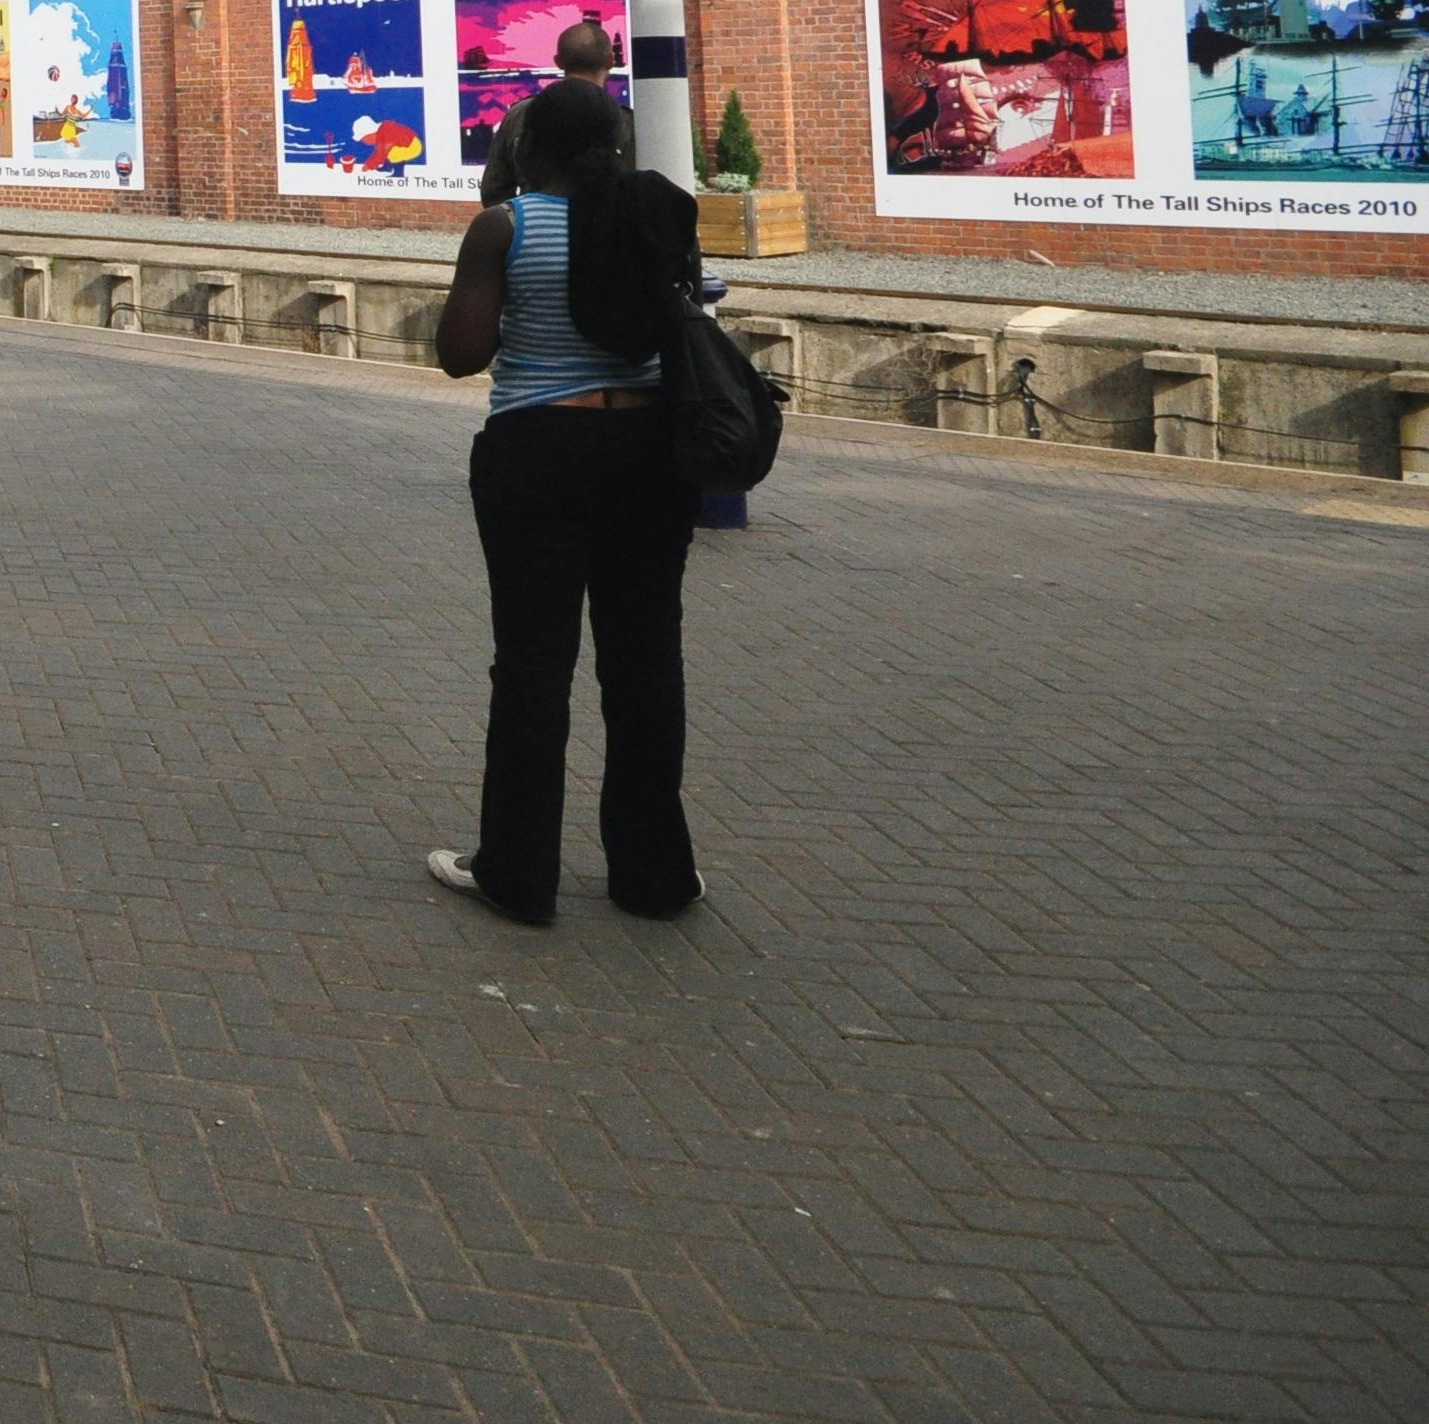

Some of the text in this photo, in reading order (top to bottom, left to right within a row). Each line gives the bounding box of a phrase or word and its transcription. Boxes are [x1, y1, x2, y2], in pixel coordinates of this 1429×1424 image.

[5, 167, 20, 176] The
[22, 168, 36, 177] Tall
[37, 168, 60, 179] Ships
[63, 169, 87, 179] Races
[89, 170, 110, 179] 2010
[357, 176, 394, 187] Home
[398, 177, 409, 188] of
[414, 177, 438, 188] The
[441, 178, 463, 189] Tall
[1013, 192, 1417, 217] Home of The Tall Ships Races 2010
